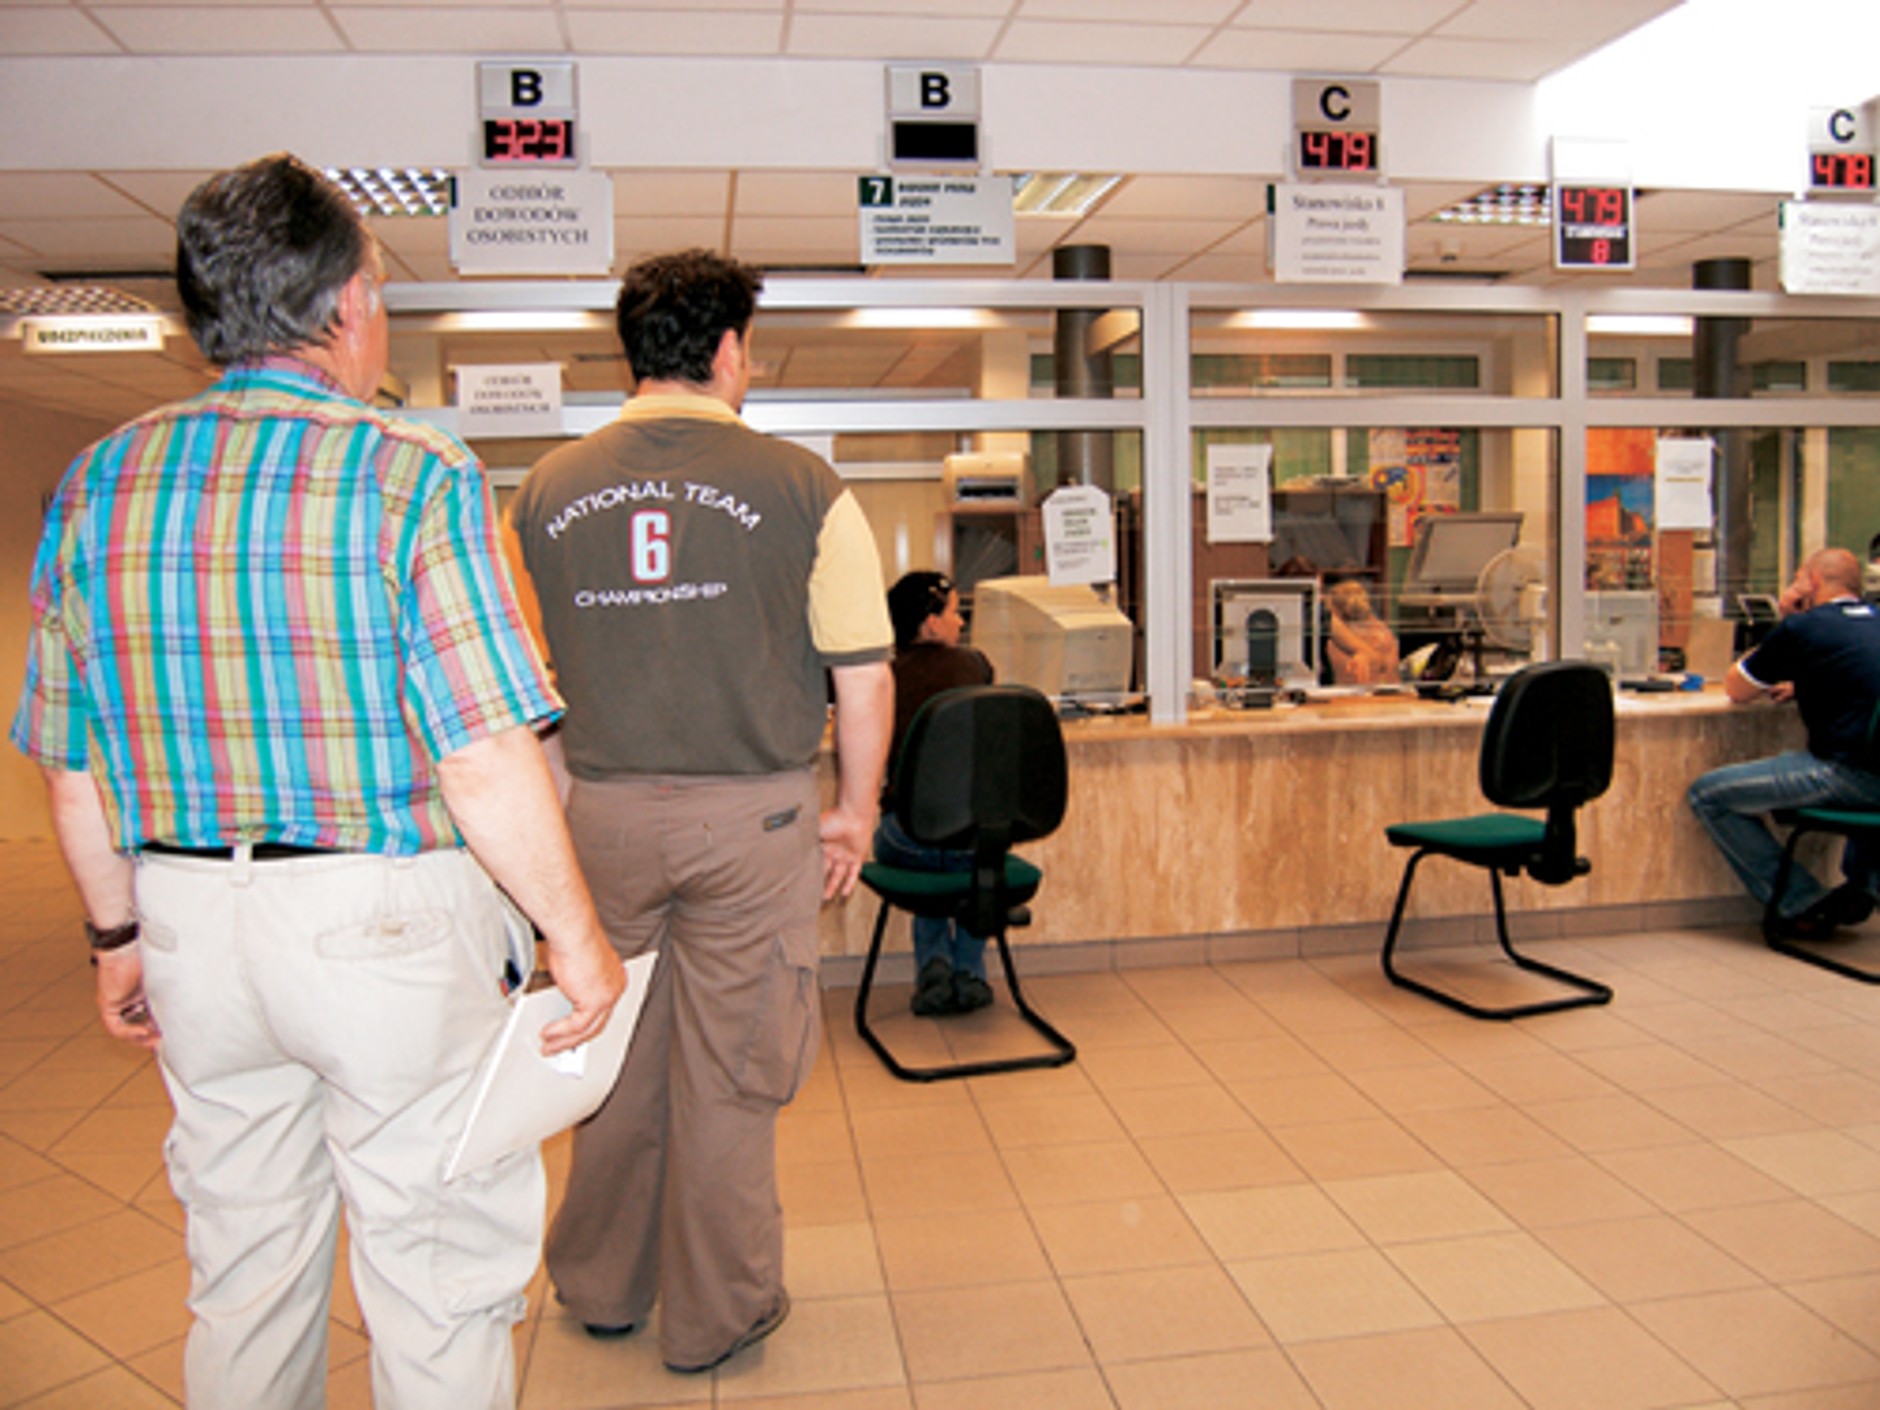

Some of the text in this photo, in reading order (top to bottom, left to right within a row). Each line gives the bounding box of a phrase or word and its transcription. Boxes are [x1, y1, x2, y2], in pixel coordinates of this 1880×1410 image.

[511, 70, 543, 107] B
[920, 72, 950, 109] B
[1320, 85, 1351, 122] C
[493, 119, 566, 161] 323
[1829, 109, 1856, 143] C
[1306, 131, 1370, 171] 479
[1814, 153, 1872, 187] 478
[867, 180, 885, 205] 7
[1563, 187, 1623, 227] 479
[545, 480, 763, 539] NATIONAL TEAM
[629, 508, 674, 584] 6
[574, 581, 729, 607] CHAMPIONSHIP
